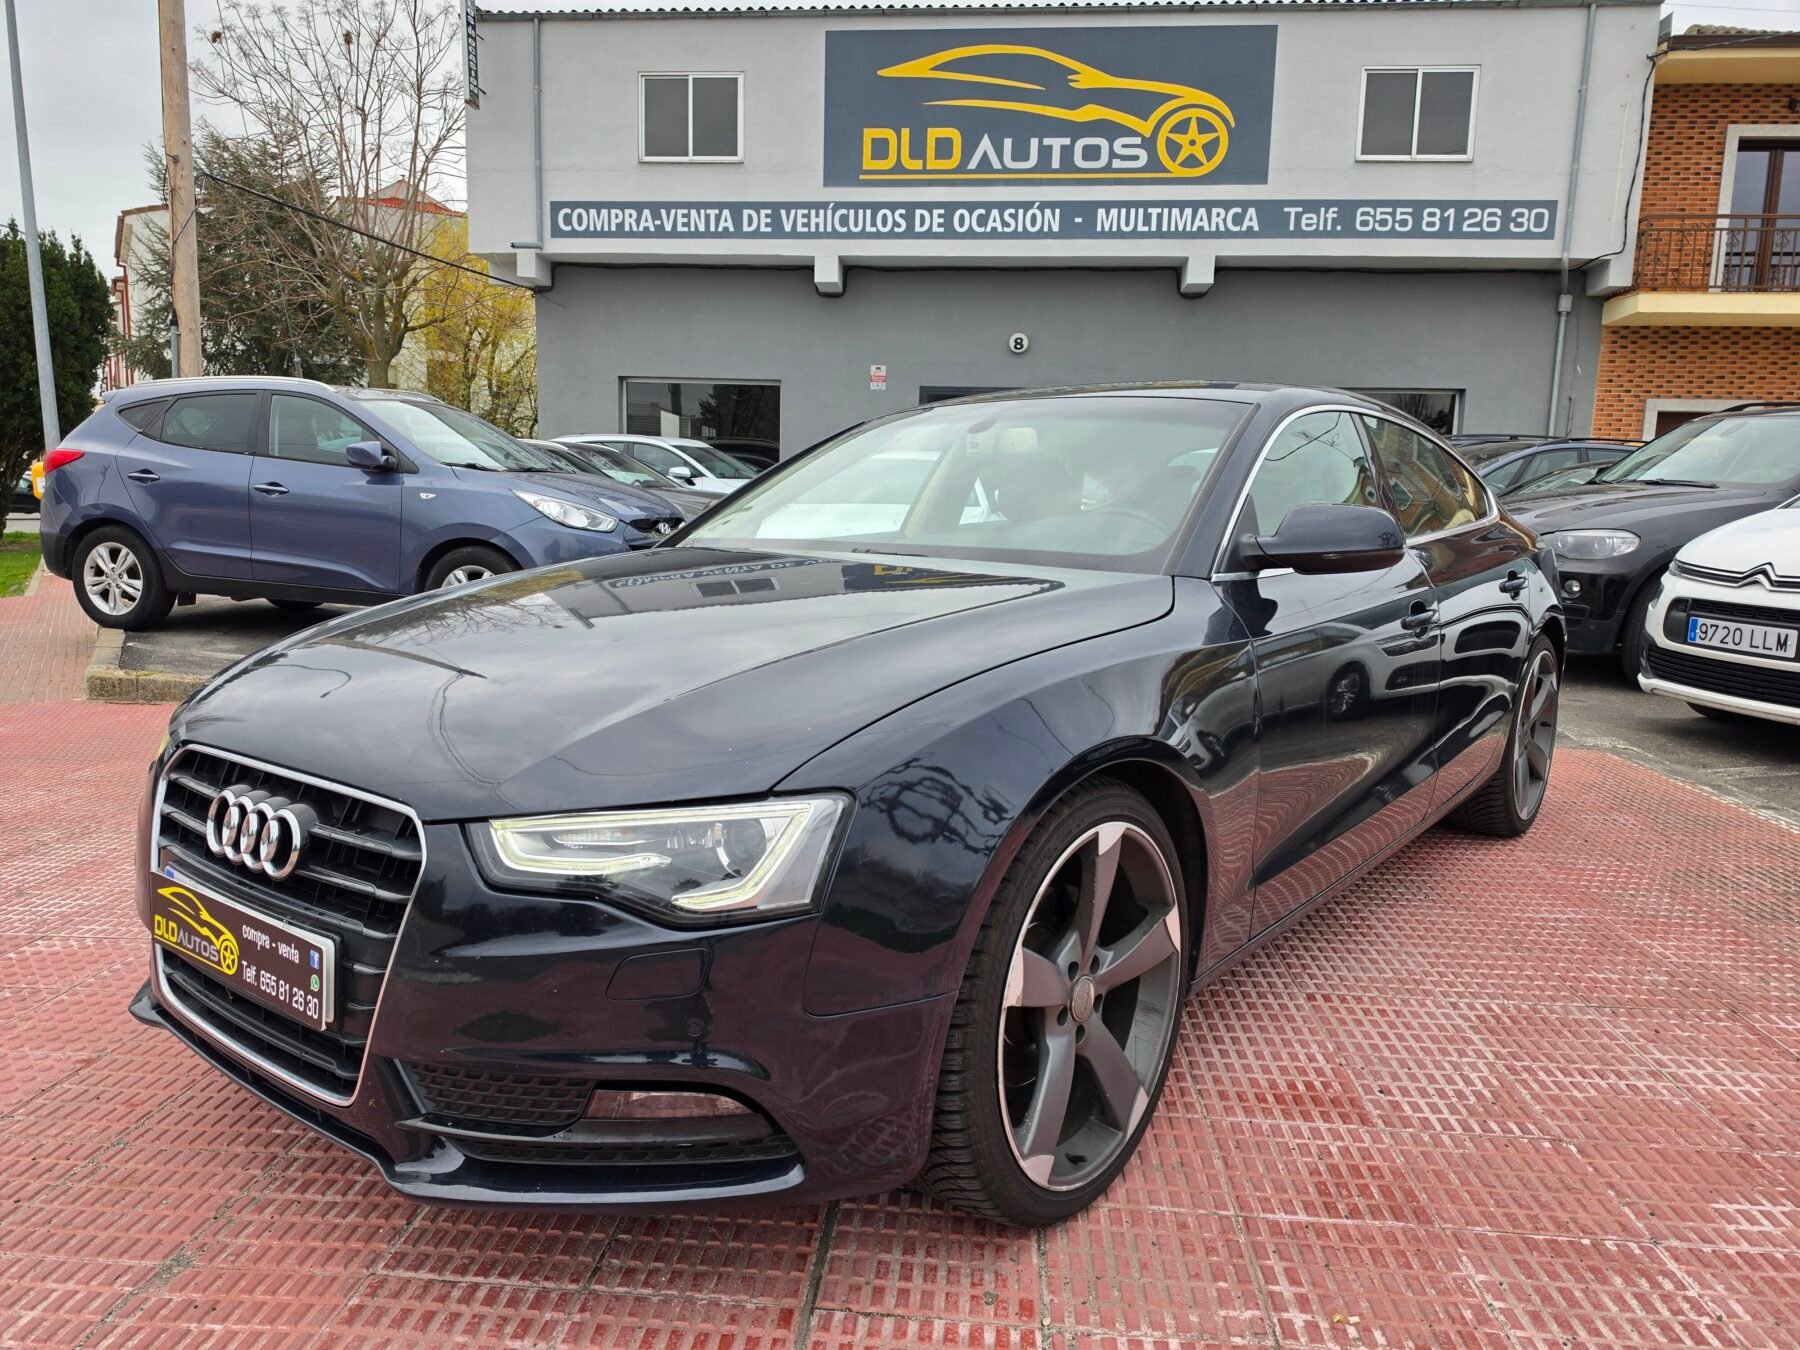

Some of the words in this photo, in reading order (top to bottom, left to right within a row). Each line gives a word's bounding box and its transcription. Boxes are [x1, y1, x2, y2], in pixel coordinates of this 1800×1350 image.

[863, 127, 962, 170] DLD
[966, 133, 1149, 170] AUTOS
[557, 207, 734, 233] COMPRA-VENTA
[742, 207, 772, 233] DE
[780, 202, 907, 233] VEHÍCULOS
[914, 207, 945, 233] DE
[952, 202, 1060, 233] OCASIÓN
[1096, 207, 1260, 232] MULTIMARCA
[1283, 207, 1342, 232] Telf.
[1355, 207, 1413, 232] 655
[1422, 208, 1455, 232] 81
[1462, 208, 1502, 233] 26
[1509, 208, 1549, 233] 30
[1013, 337, 1024, 350] 8
[1698, 623, 1743, 646] 9720
[1749, 629, 1789, 652] LLM
[154, 913, 178, 946] DLD
[177, 929, 219, 962] AUTOS
[242, 924, 270, 951] compra
[278, 941, 299, 964] venta
[241, 960, 257, 986] Telf.
[260, 970, 277, 996] 655
[278, 981, 290, 1003] 81
[292, 987, 305, 1012] 26
[306, 996, 319, 1020] 30
